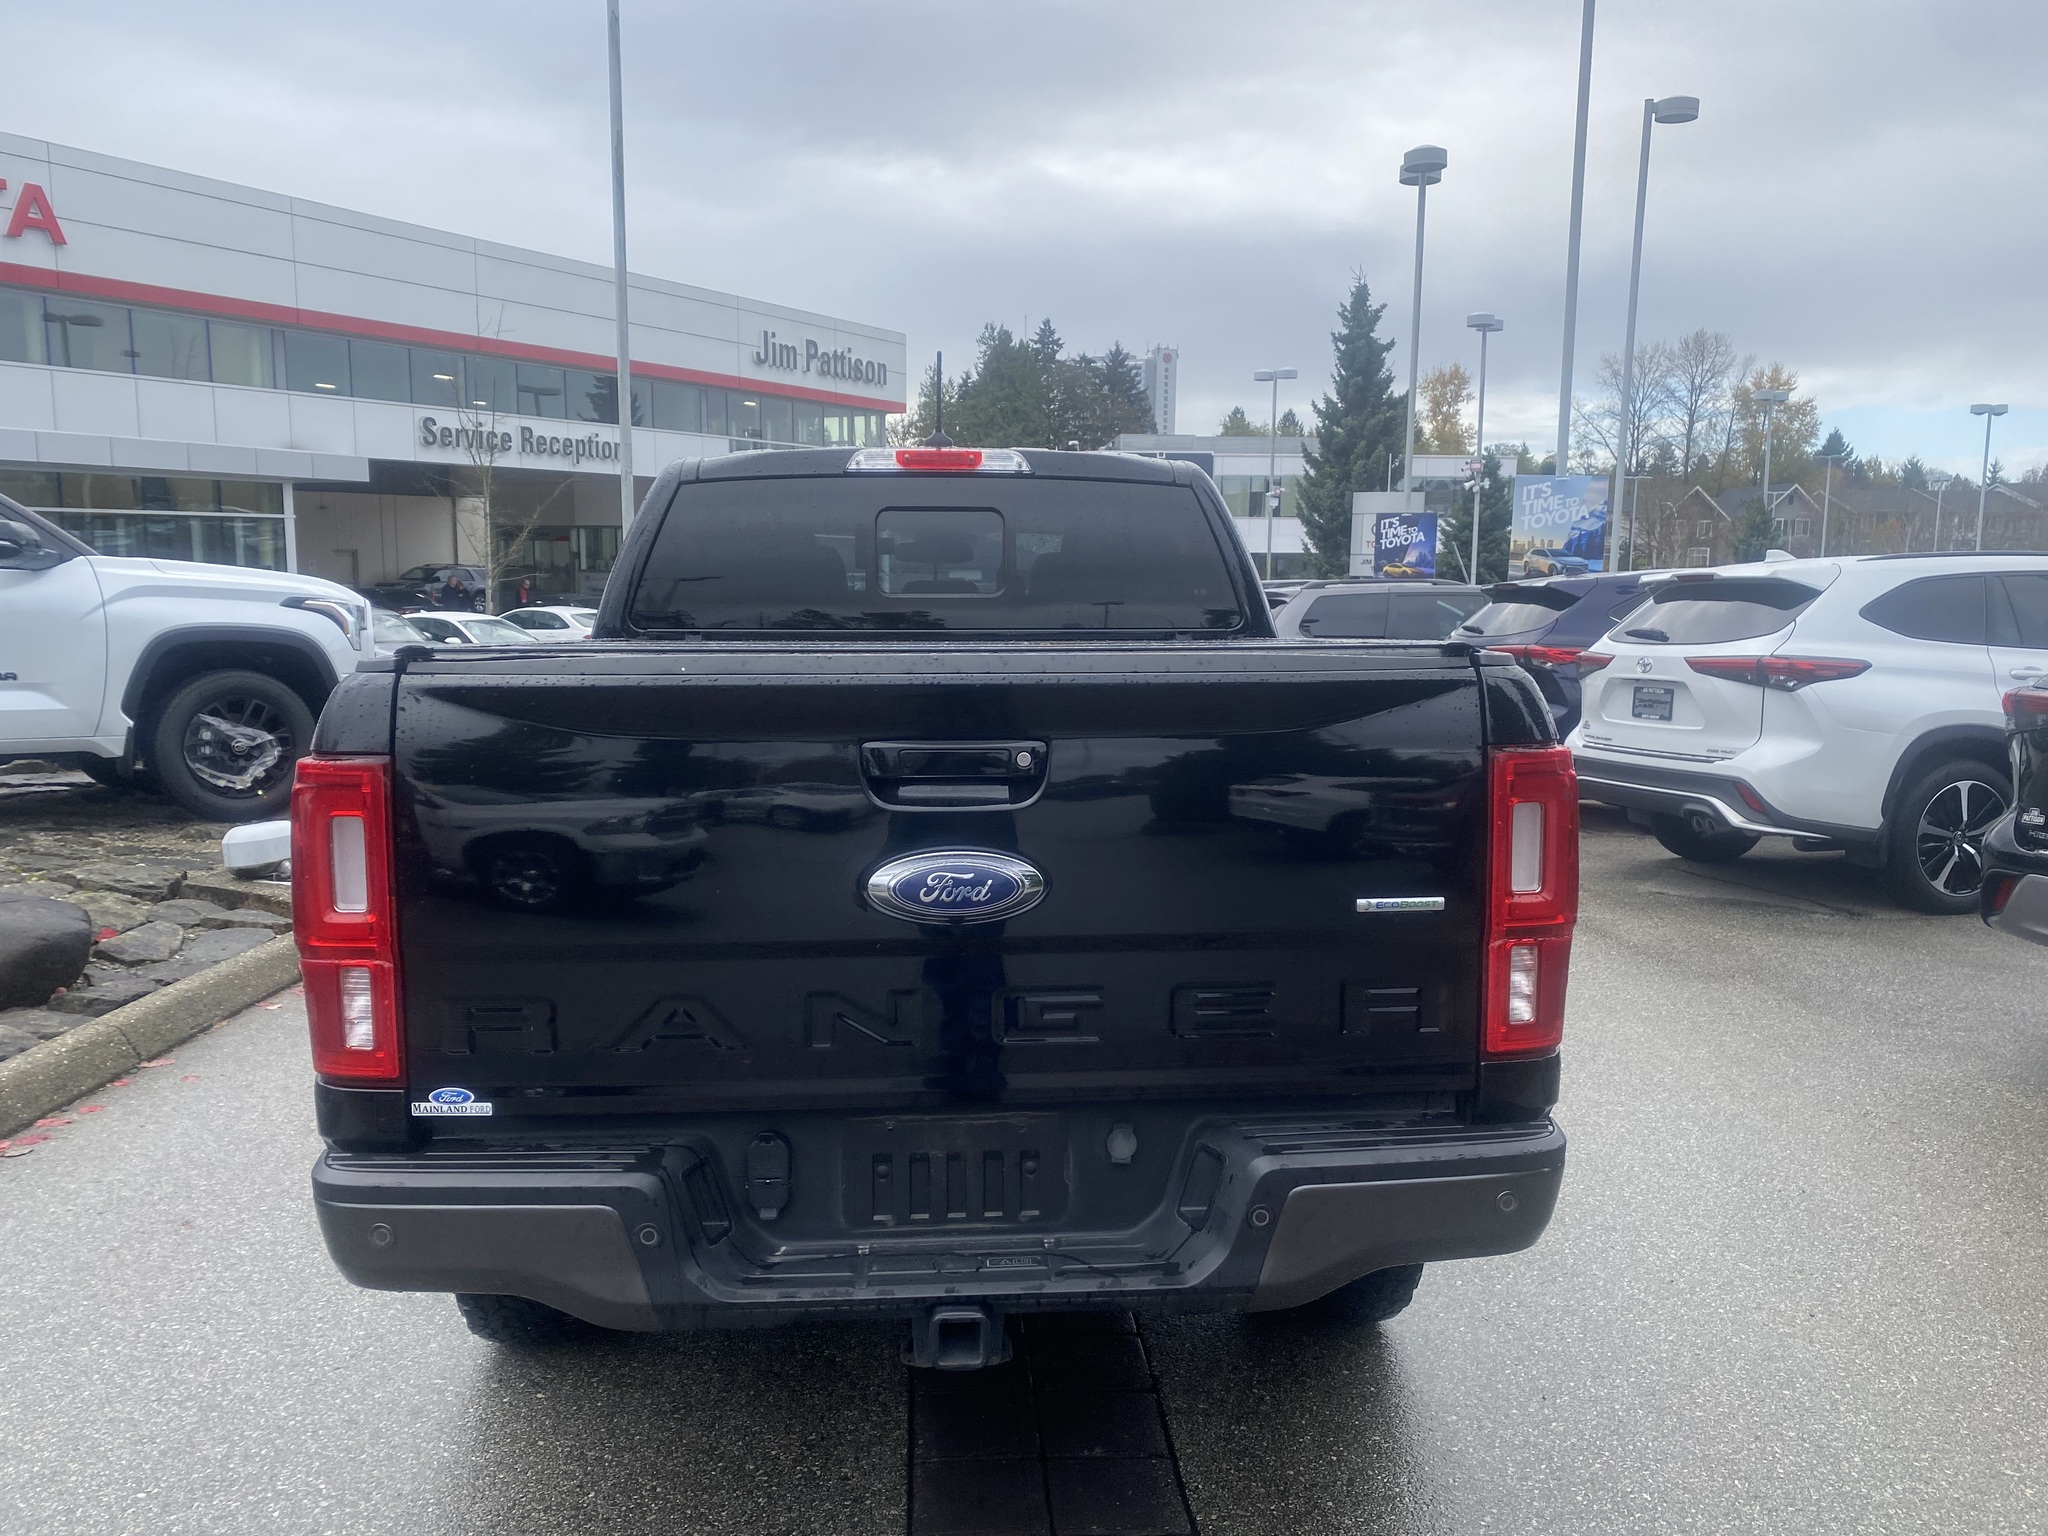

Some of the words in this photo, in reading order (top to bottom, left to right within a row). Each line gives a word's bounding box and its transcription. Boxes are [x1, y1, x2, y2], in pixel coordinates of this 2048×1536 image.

[754, 329, 798, 370] Jim
[803, 338, 887, 386] Pattison
[420, 416, 513, 453] Service
[1522, 482, 1552, 501] IT'S
[1522, 494, 1564, 515] TIME
[1564, 497, 1580, 507] TO
[1381, 516, 1400, 530] IT'S
[1521, 504, 1590, 531] TOYOTA
[1380, 532, 1425, 550] TOYOTA
[1381, 525, 1408, 540] TIME
[1408, 526, 1418, 535] TO
[919, 872, 992, 903] Ford
[425, 981, 1450, 1055] RANGER
[439, 1091, 464, 1102] Ford
[413, 1103, 467, 1113] MAINLAND
[470, 1105, 491, 1113] FORD
